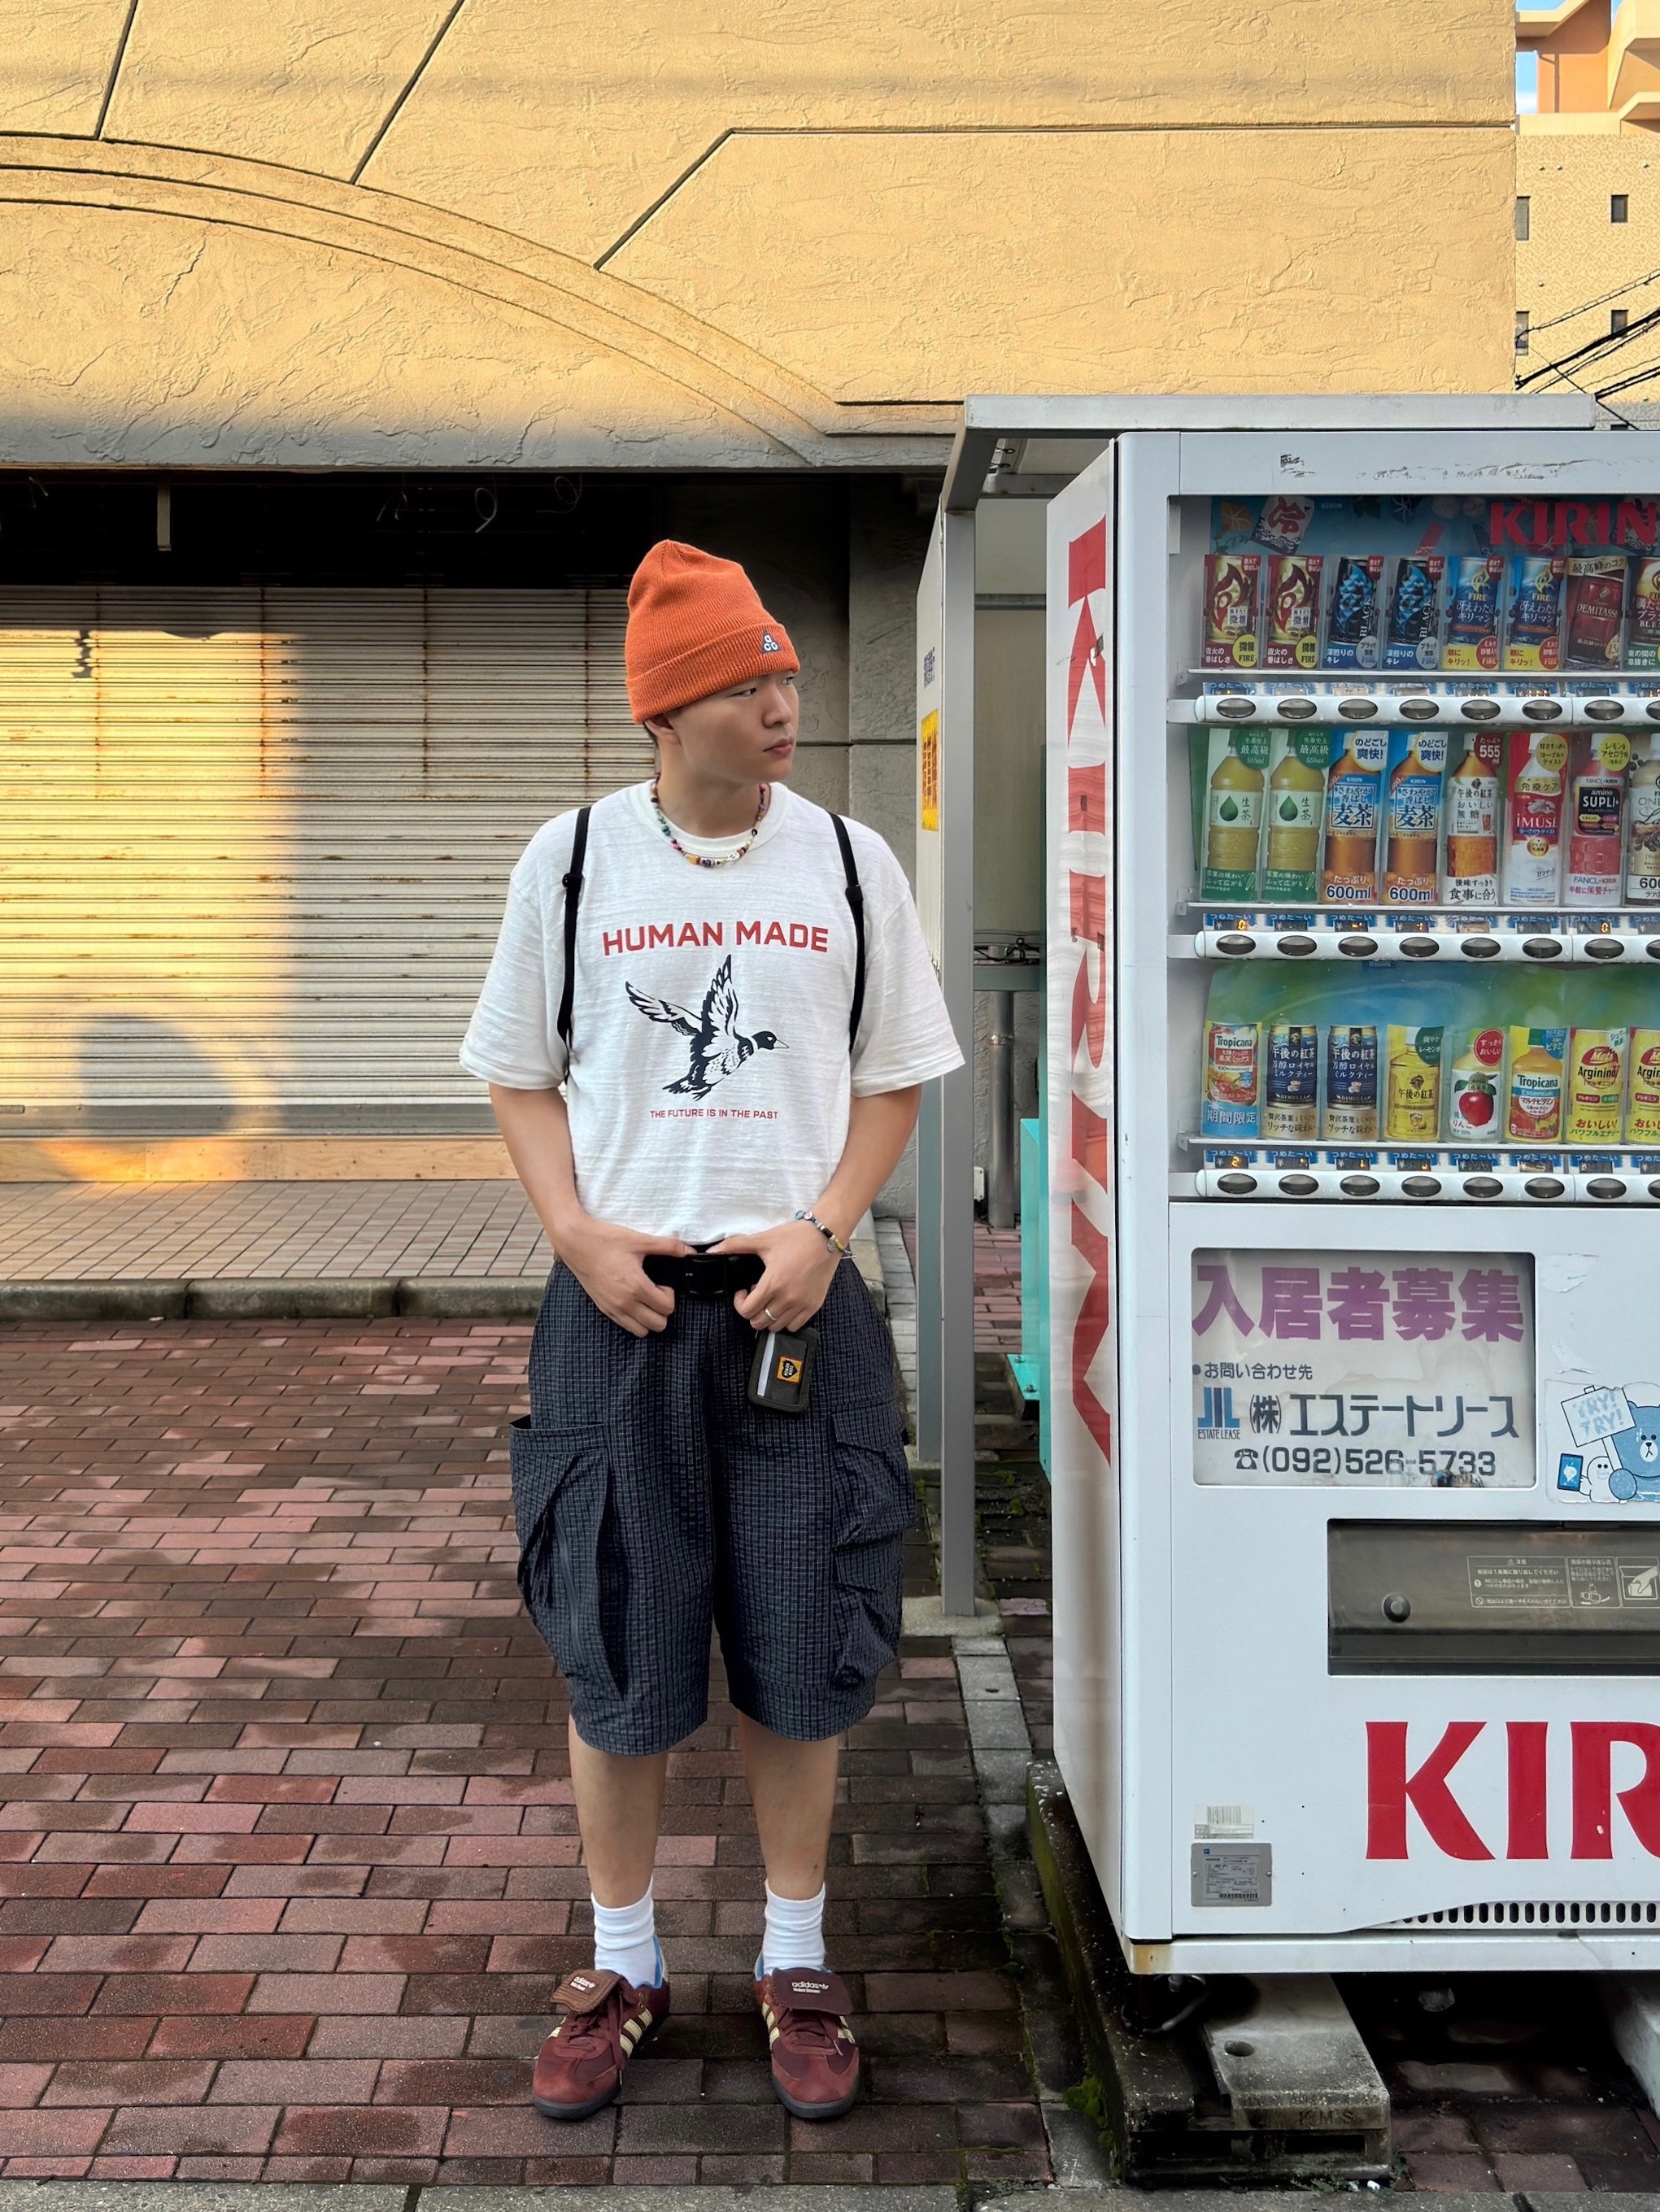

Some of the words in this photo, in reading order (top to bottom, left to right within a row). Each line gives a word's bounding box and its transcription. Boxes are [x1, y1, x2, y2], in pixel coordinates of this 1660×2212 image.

[1490, 501, 1657, 546] KIRIN
[1468, 593, 1487, 602] FIRE
[1531, 594, 1551, 603] FIRE
[1359, 598, 1372, 638] BLACK
[1419, 599, 1432, 638] BLACK
[1205, 647, 1225, 655] 直火の
[1267, 648, 1288, 656] 直火の
[1205, 655, 1231, 664] 香ばしさ
[1239, 655, 1254, 663] FIRE
[1267, 656, 1294, 664] 香ばしさ
[1301, 655, 1316, 664] FIRE
[1355, 738, 1388, 747] のどごし
[1418, 739, 1447, 748] のどごし
[1240, 745, 1269, 755] 最高級
[1300, 745, 1329, 755] 最高級
[1357, 748, 1383, 760] 爽快!
[1420, 750, 1444, 761] 爽快!
[1479, 744, 1501, 759] 555
[1521, 782, 1558, 792] 免疫ケア
[1457, 788, 1493, 799] 午後の紅茶
[1240, 796, 1251, 821] 生茶
[1301, 796, 1312, 821] 生茶
[1457, 800, 1493, 810] おいしい
[1333, 803, 1372, 827] 麦茶
[1397, 805, 1435, 828] 麦茶
[1457, 810, 1479, 820] 無糖
[1334, 874, 1367, 885] たっぷり
[1396, 876, 1431, 886] たっぷり
[1455, 878, 1493, 887] 後味すっきり
[1574, 877, 1599, 885] FANCL
[1326, 884, 1372, 900] 600ml
[1389, 886, 1434, 901] 600ml
[1449, 887, 1497, 901] 食事に合う
[603, 922, 723, 956] HUMAN
[735, 921, 829, 952] MADE
[1067, 514, 1113, 1469] KIRIN
[1217, 1035, 1253, 1048] Tropicana
[1272, 1047, 1315, 1060] 午後の紅茶
[1332, 1047, 1376, 1060] 午後の紅茶
[1479, 1047, 1501, 1056] おいしい
[1334, 1070, 1374, 1079] ミルクティー
[1578, 1066, 1617, 1080] Arginine
[1517, 1074, 1558, 1090] Tropicana
[1398, 1088, 1434, 1099] 午後の紅茶
[1521, 1097, 1554, 1105] マルチビタミン
[650, 1110, 666, 1118] THE
[668, 1109, 704, 1117] FUTURE
[706, 1108, 716, 1117] IS
[718, 1108, 728, 1117] IN
[730, 1109, 750, 1118] THE
[753, 1110, 778, 1119] PAST
[1207, 1109, 1257, 1125] 期間限定
[1575, 1118, 1619, 1130] おいしい!
[1192, 1265, 1524, 1343] 入居者募集
[1205, 1362, 1314, 1381] お問い合わせ先
[1579, 1409, 1624, 1436] TRY!
[1198, 1429, 1220, 1439] ESTATE
[1220, 1429, 1241, 1439] LEASE
[1262, 1445, 1497, 1477] (092)526-5733
[791, 1981, 819, 1989] adidas
